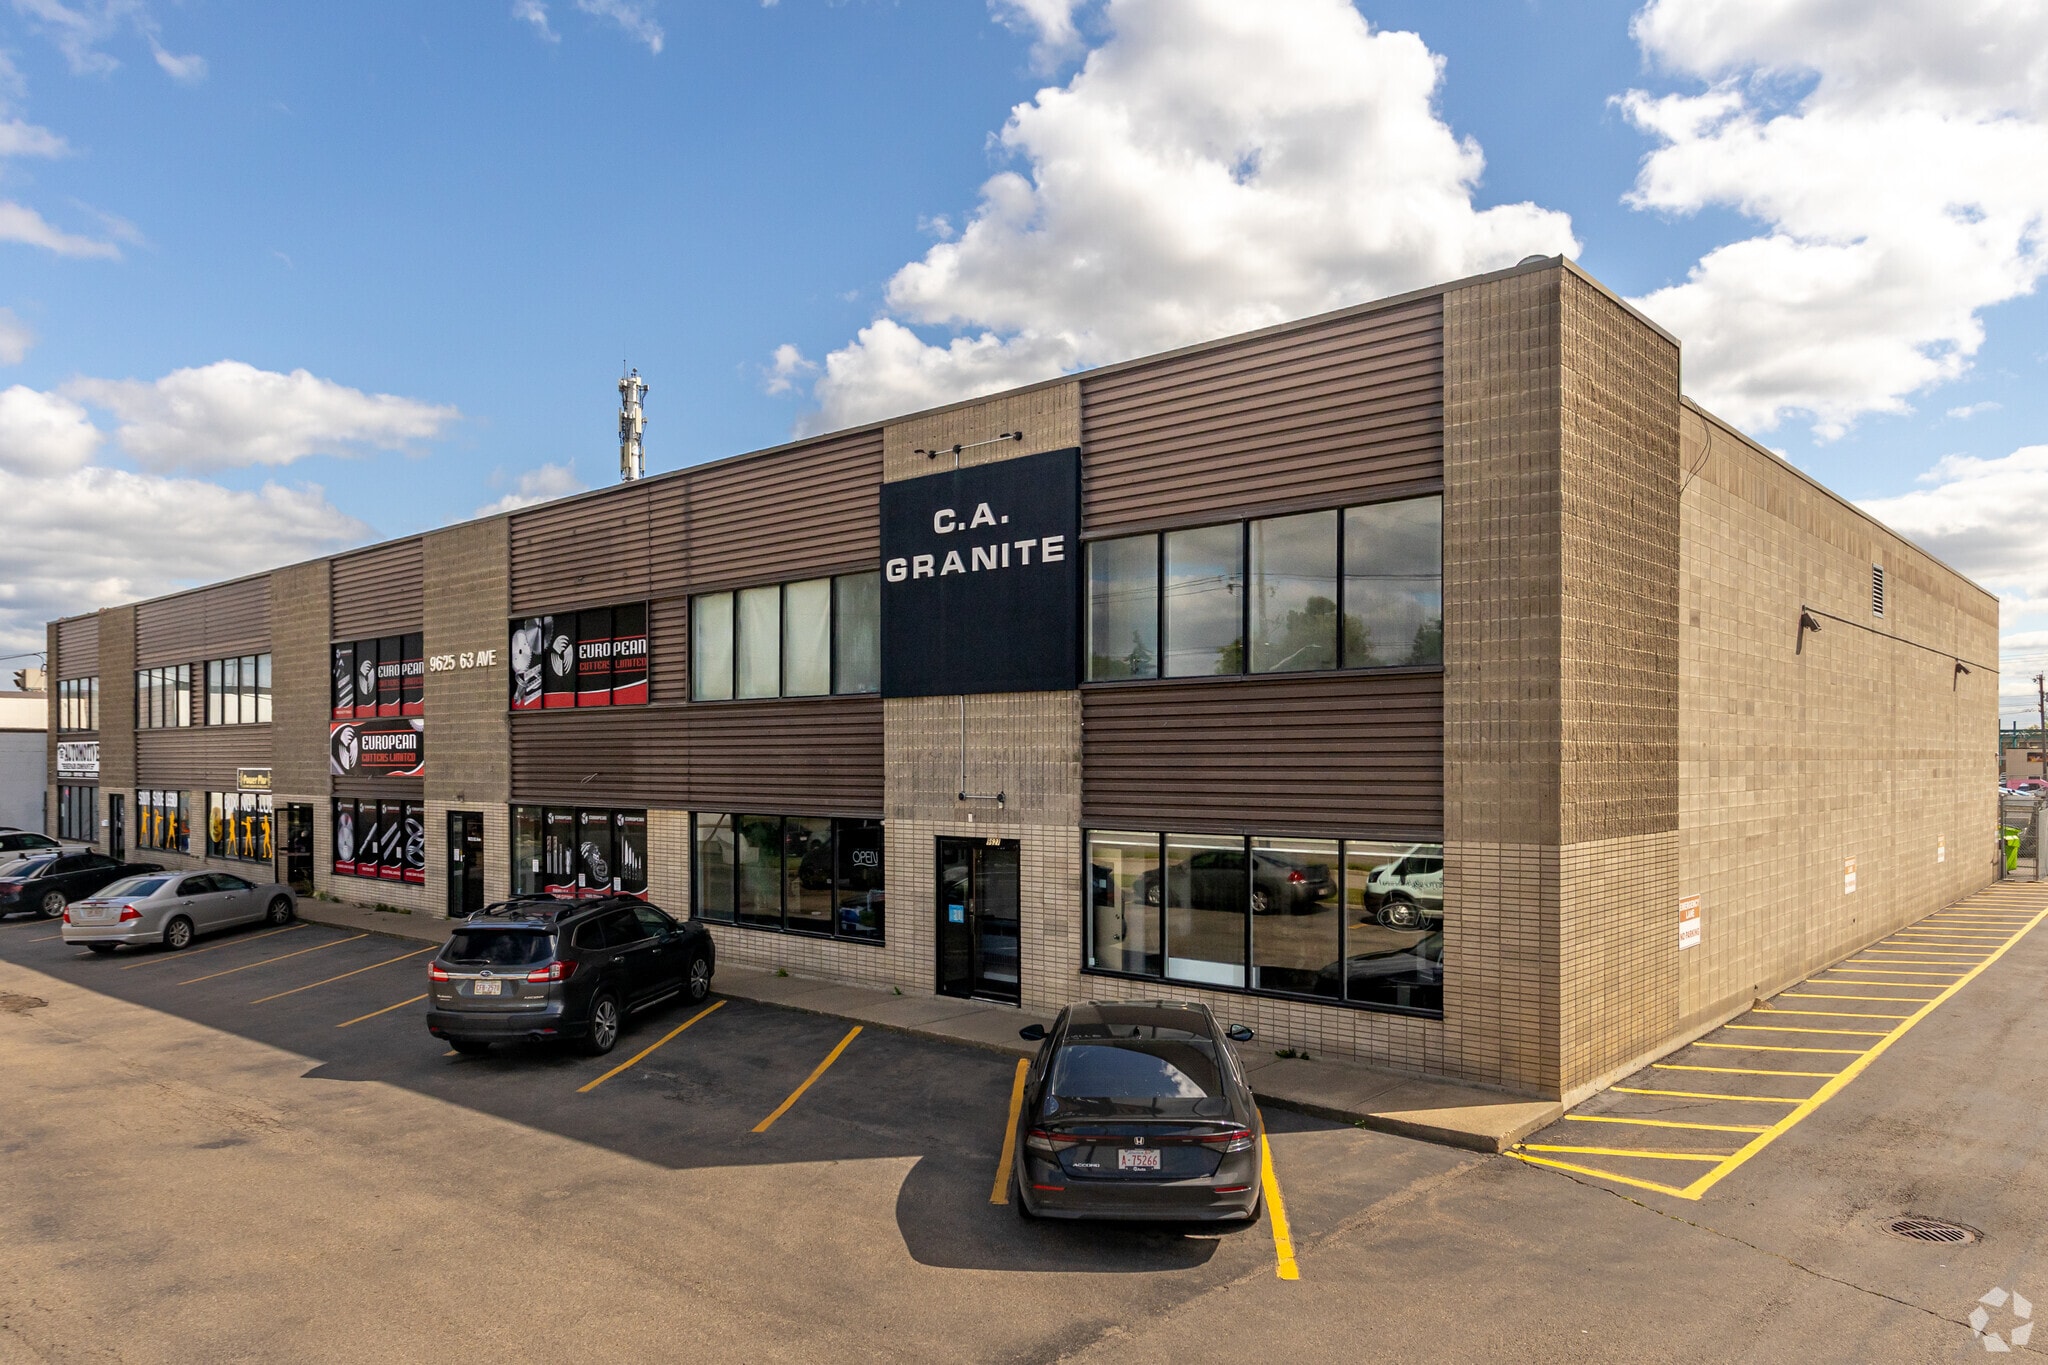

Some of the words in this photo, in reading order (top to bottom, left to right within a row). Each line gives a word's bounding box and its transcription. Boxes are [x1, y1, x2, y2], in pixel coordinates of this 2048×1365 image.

[933, 502, 1009, 534] C.A.
[886, 535, 1065, 582] GRANITE
[578, 639, 647, 659] EUROPEAN
[377, 661, 424, 678] EUROPEAN
[430, 655, 456, 672] 9625
[460, 652, 474, 669] 63
[476, 650, 497, 667] AVE
[614, 657, 647, 669] LIMITED
[362, 734, 416, 750] EUROPEAN
[852, 850, 879, 865] OPEN
[1121, 1155, 1158, 1166] A-75266
